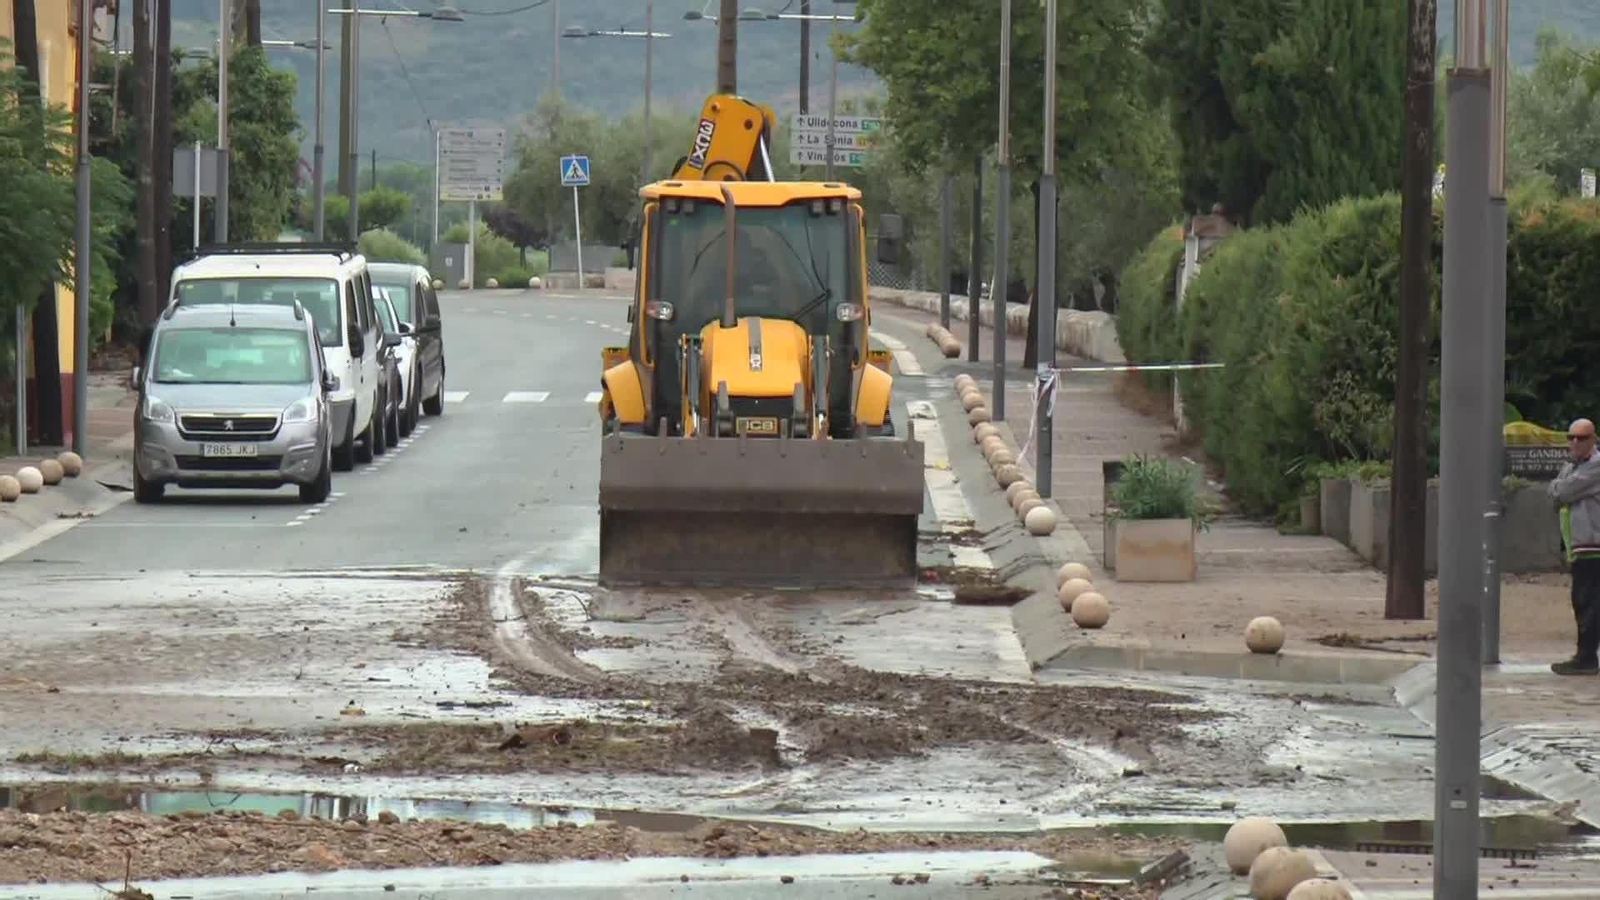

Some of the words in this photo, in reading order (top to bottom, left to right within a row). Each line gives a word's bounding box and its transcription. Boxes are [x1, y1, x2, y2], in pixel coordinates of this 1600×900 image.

[807, 117, 858, 128] Ulldcona
[807, 135, 819, 144] La
[206, 444, 232, 455] 7865
